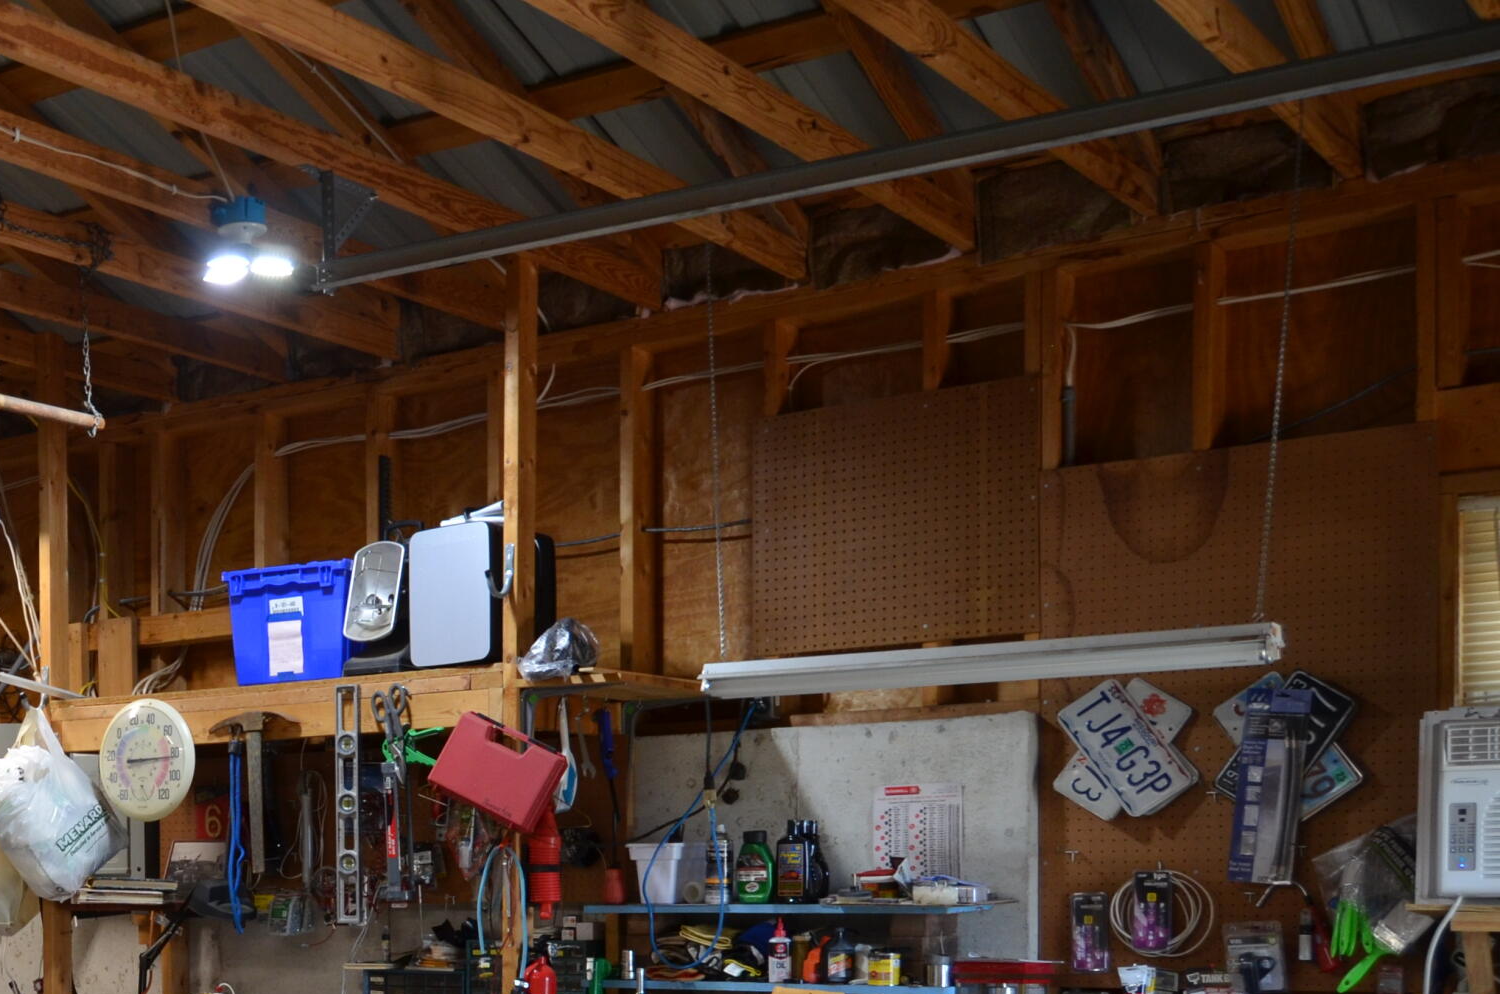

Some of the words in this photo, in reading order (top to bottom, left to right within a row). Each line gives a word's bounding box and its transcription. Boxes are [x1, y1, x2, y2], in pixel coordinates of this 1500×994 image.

[130, 716, 139, 726] 20
[146, 713, 155, 724] 40
[117, 728, 122, 739] 0
[164, 725, 172, 736] 60
[171, 747, 179, 758] 80
[169, 770, 180, 780] 100
[1116, 745, 1174, 795] G3P
[158, 789, 169, 800] 120
[205, 803, 221, 837] 6
[56, 803, 108, 852] MENARD
[776, 961, 786, 969] OIL
[1201, 974, 1223, 983] TANK
